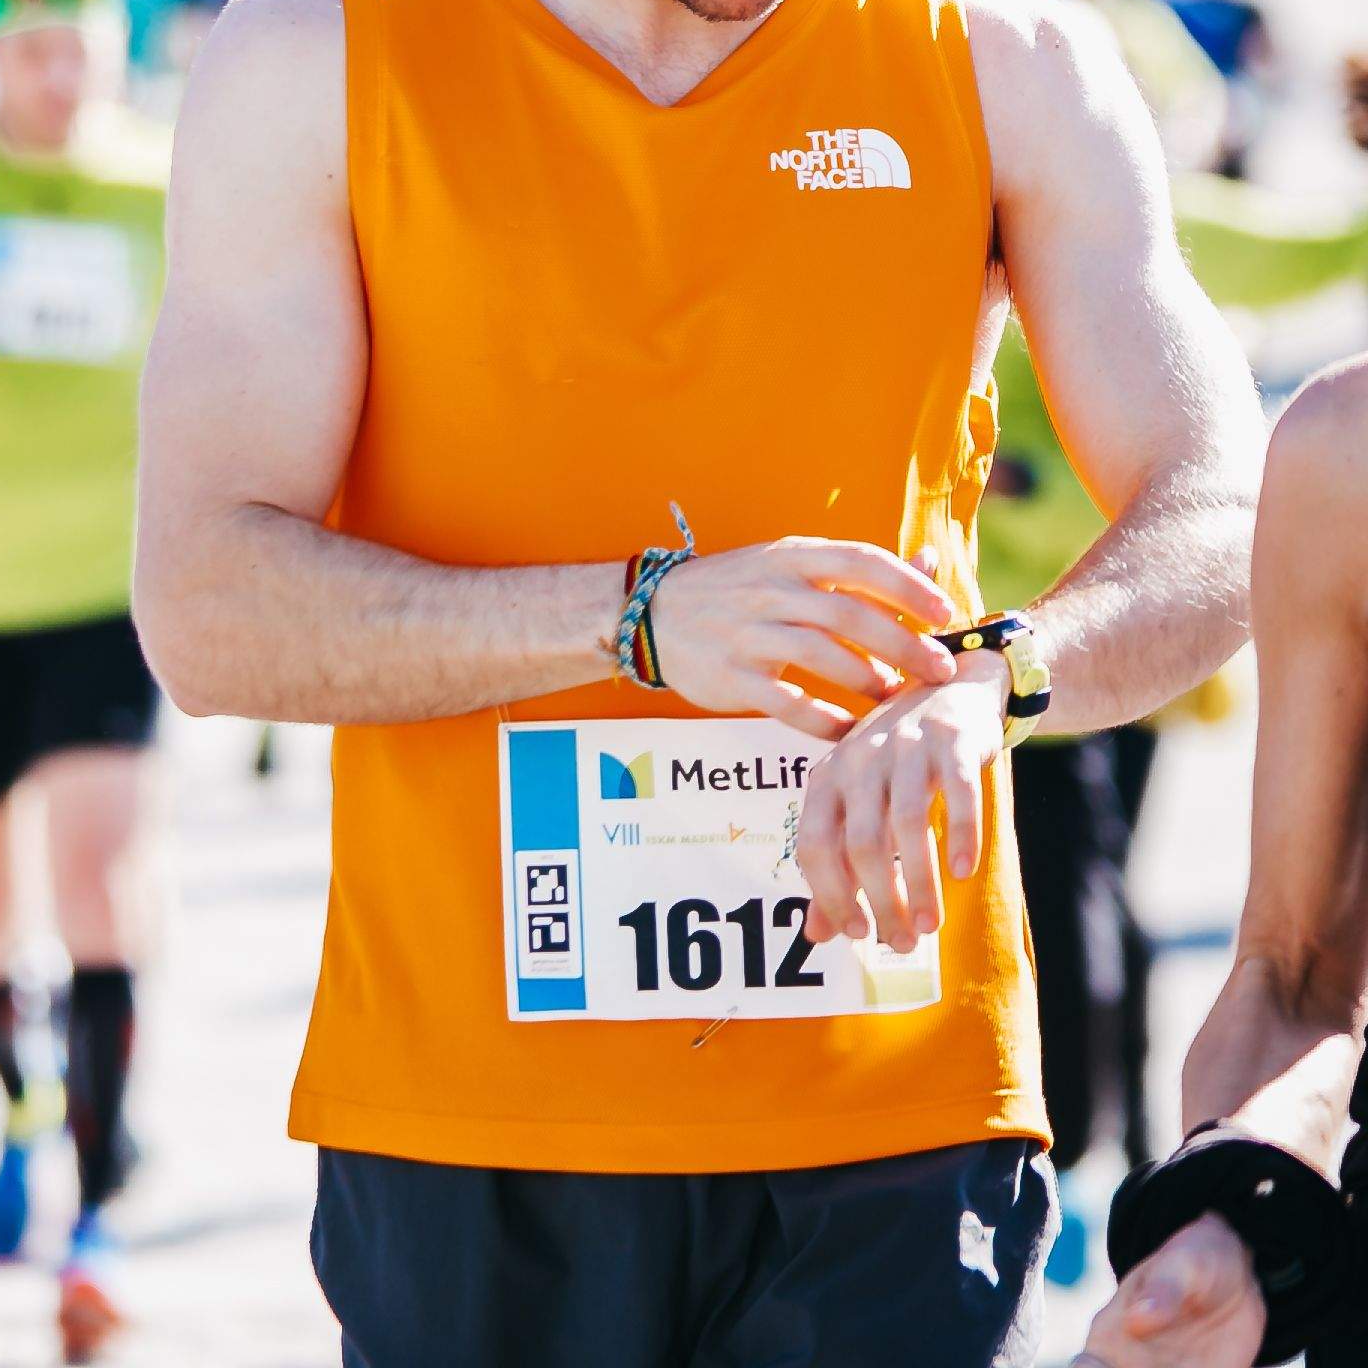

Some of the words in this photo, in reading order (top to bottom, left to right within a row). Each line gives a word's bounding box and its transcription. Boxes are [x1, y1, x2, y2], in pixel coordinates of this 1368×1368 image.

[806, 129, 858, 150] THE
[770, 149, 861, 171] NORTH
[797, 168, 864, 190] FACE
[671, 756, 809, 791] MetLif
[602, 823, 640, 845] VIII
[618, 897, 825, 992] 1612
